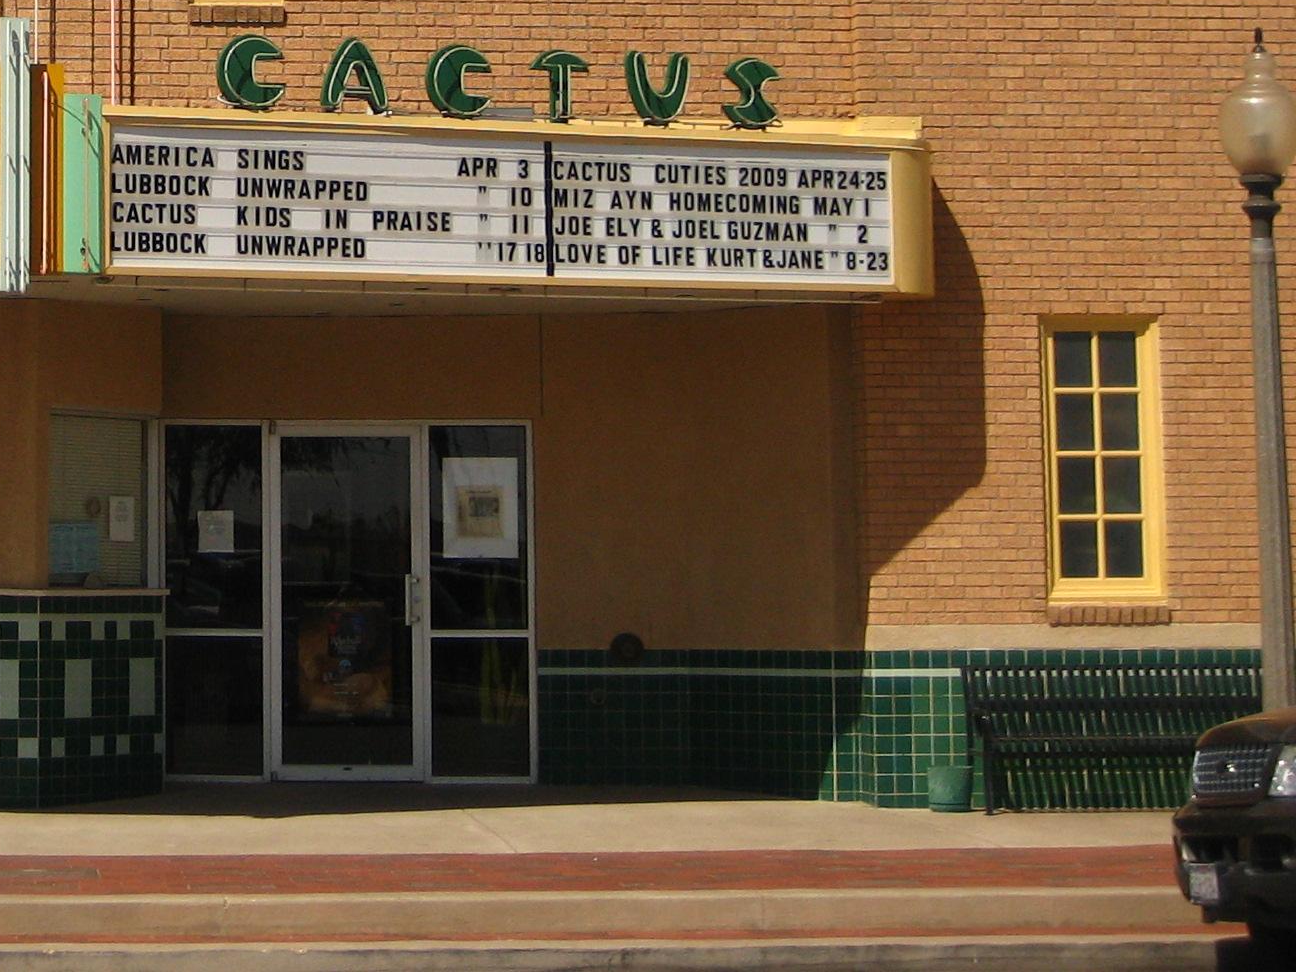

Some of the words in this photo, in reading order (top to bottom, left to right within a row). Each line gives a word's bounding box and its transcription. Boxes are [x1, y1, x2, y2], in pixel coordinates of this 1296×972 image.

[216, 34, 783, 130] CACTUS
[112, 144, 214, 168] AMERICA
[237, 149, 304, 171] SINGS
[457, 157, 497, 178] APR
[518, 159, 529, 179] 3
[554, 161, 631, 183] CACTUS
[655, 164, 726, 186] CUTIES
[739, 167, 786, 188] 2009
[112, 174, 210, 197] LUBBOCK
[237, 178, 367, 202] UNWRAPPED
[511, 187, 532, 207] 10
[554, 188, 593, 208] MIZ
[610, 191, 652, 211] AYN
[669, 192, 800, 215] HOMECOMING
[813, 196, 854, 217] MAY
[112, 202, 195, 224] CACTUS
[237, 205, 290, 228] KIDS
[325, 209, 347, 230] IN
[372, 211, 451, 232] PRAISE
[512, 214, 529, 235] 11
[555, 215, 592, 236] JOE
[606, 218, 641, 238] ELY
[651, 218, 663, 238] &
[672, 220, 720, 240] JOEL
[727, 221, 808, 242] GUZMAN
[857, 224, 868, 244] 2
[112, 231, 206, 254] LUBBOCK
[237, 234, 365, 258] UNWRAPPED
[498, 242, 517, 262] 17
[526, 243, 544, 263] 18
[555, 243, 606, 263] LOVE
[618, 245, 641, 265] OF
[652, 246, 695, 266] LIFE
[706, 248, 757, 268] KURT
[847, 251, 888, 270] 8-23
